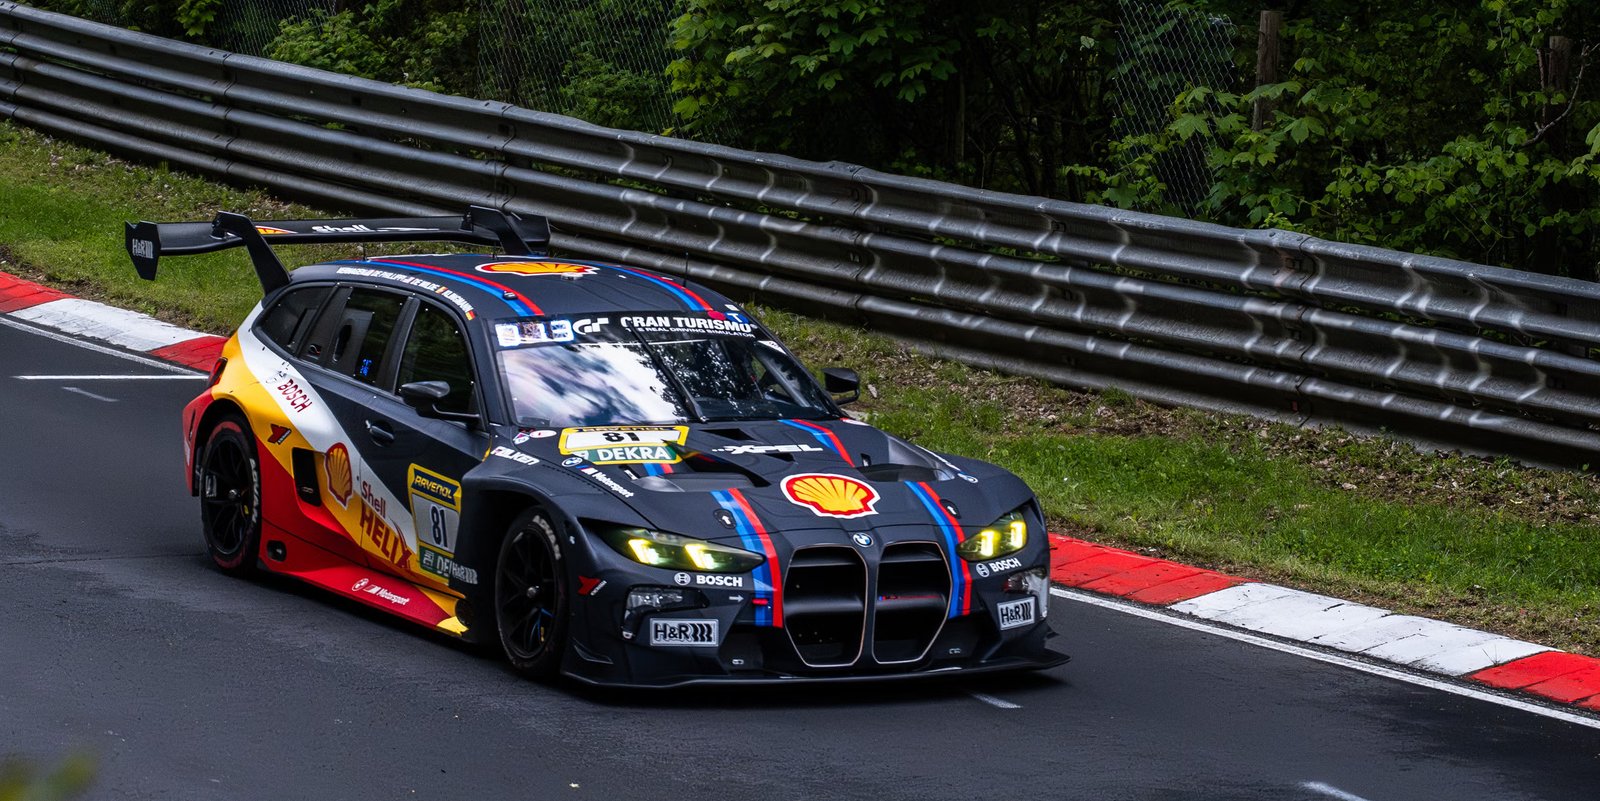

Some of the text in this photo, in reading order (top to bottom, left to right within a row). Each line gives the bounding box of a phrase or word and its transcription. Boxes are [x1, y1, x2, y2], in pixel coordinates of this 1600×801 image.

[312, 224, 374, 233] Shell
[706, 329, 756, 338] SIMULATOR
[277, 378, 313, 413] BOSCH
[602, 432, 640, 442] 81
[490, 446, 540, 466] FALKEN
[597, 447, 671, 460] DEKRA
[414, 475, 452, 499] RAVENOL
[592, 471, 634, 498] Motorsport
[361, 480, 386, 519] Shell
[360, 499, 412, 571] HELIX
[430, 505, 448, 548] 81
[990, 557, 1022, 573] BOSCH
[696, 575, 743, 588] BOSCH
[376, 588, 410, 606] Motorsport
[1000, 606, 1022, 624] H&R
[653, 624, 692, 641] H&R
